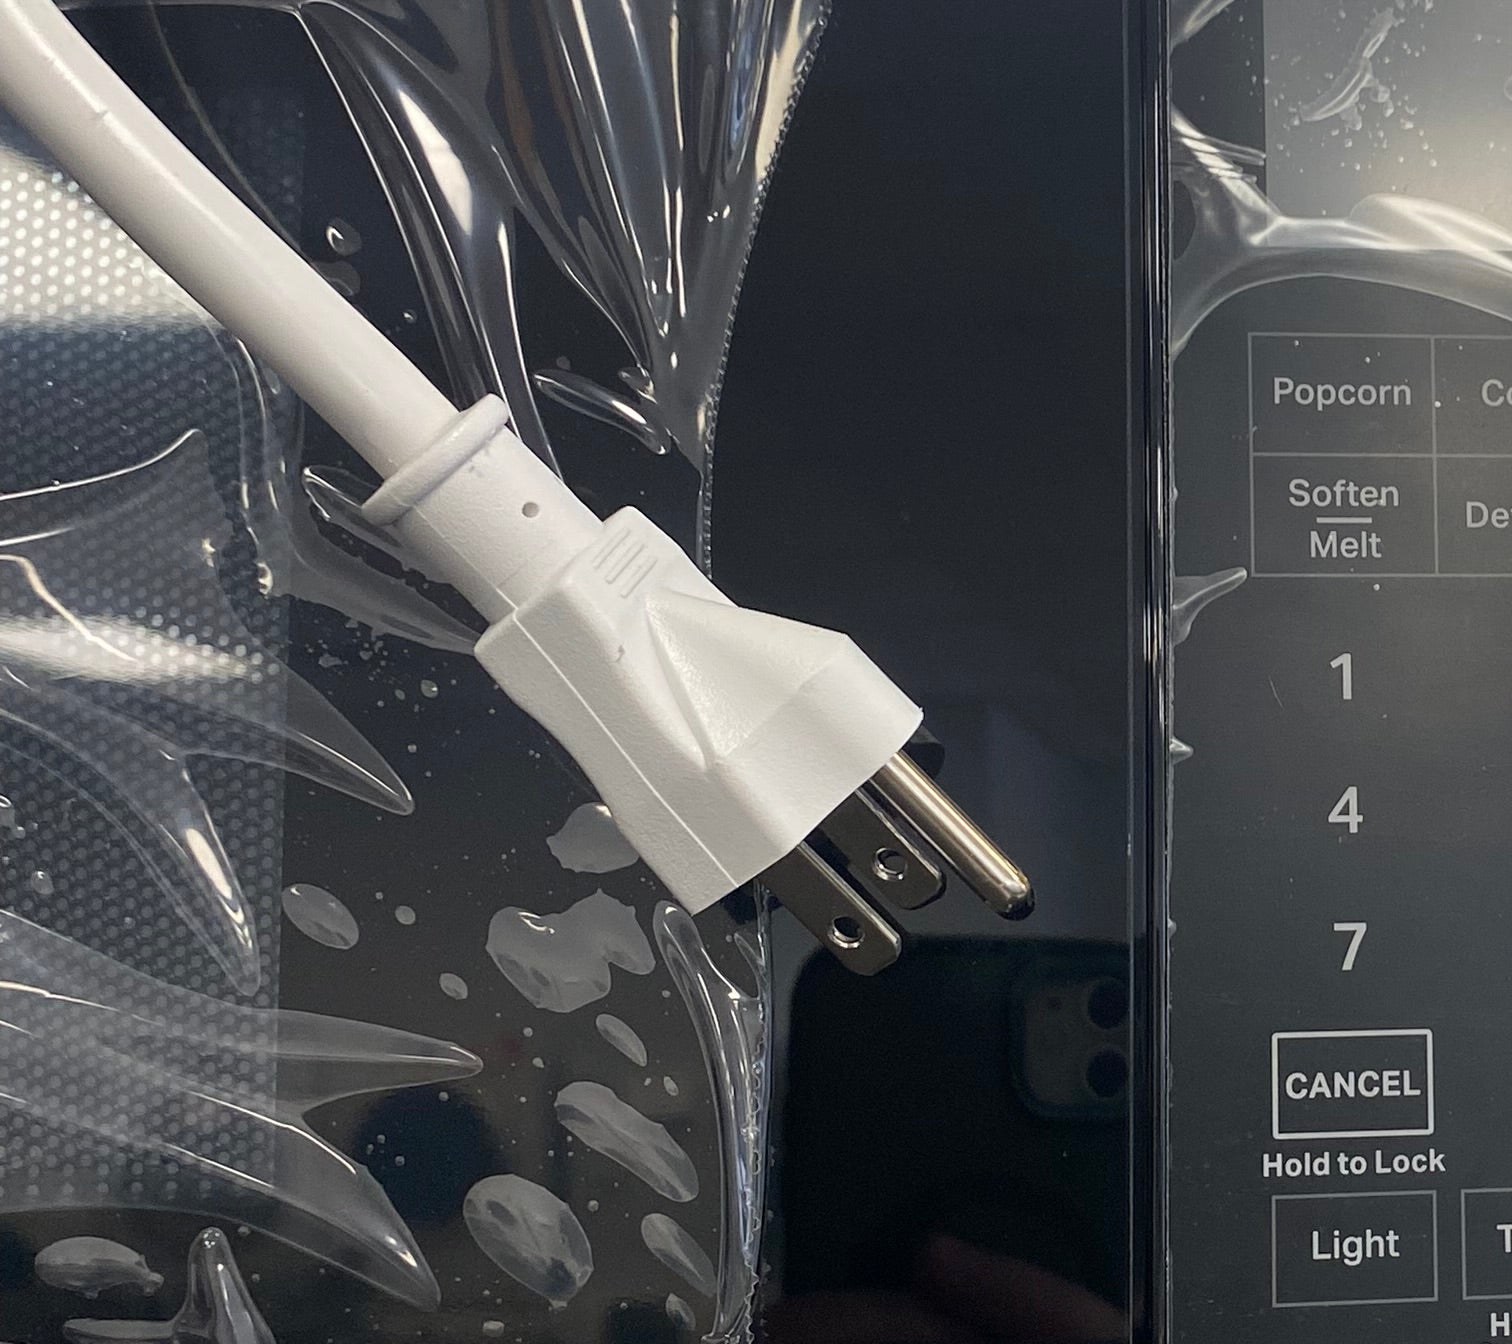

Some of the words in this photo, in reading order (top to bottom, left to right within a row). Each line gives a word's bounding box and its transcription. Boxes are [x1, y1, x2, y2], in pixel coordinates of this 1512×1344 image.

[1272, 376, 1412, 408] Popcorn
[1289, 480, 1399, 508] Soften
[1310, 532, 1382, 560] Melt
[1329, 652, 1354, 701] 1
[1328, 786, 1364, 834] 4
[1333, 922, 1368, 970] 7
[1285, 1071, 1421, 1100] CANCEL
[1262, 1152, 1330, 1178] Hold
[1336, 1152, 1367, 1175] to
[1375, 1148, 1445, 1175] Lock
[1311, 1229, 1400, 1267] Light
